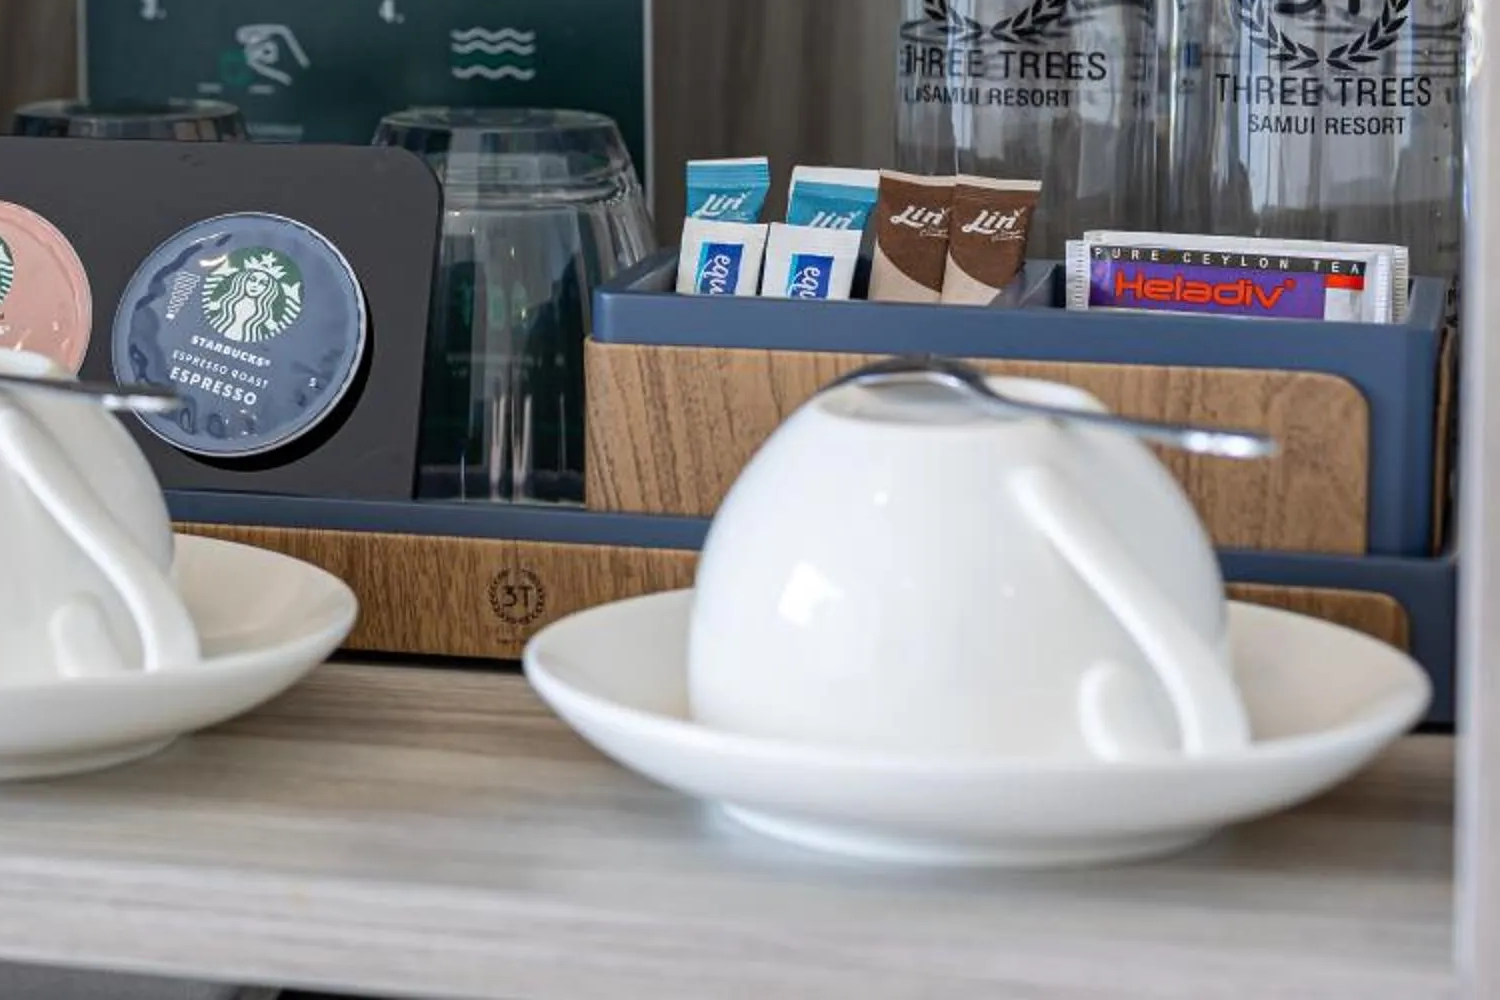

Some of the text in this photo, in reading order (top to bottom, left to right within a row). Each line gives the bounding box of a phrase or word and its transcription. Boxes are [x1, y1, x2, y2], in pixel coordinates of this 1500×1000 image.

[999, 51, 1107, 81] TREES
[922, 83, 1073, 107] SAMUI RESORT
[1215, 73, 1432, 107] THREE TREES
[1248, 115, 1406, 135] SAMUI RESORT
[890, 204, 946, 229] Lin
[961, 208, 1020, 235] Lin
[1094, 247, 1361, 274] PURE CEYLON TEA
[1114, 270, 1287, 310] Heladiv
[172, 349, 269, 390] ESPRESSO ROAST
[169, 366, 257, 406] ESPRESSO
